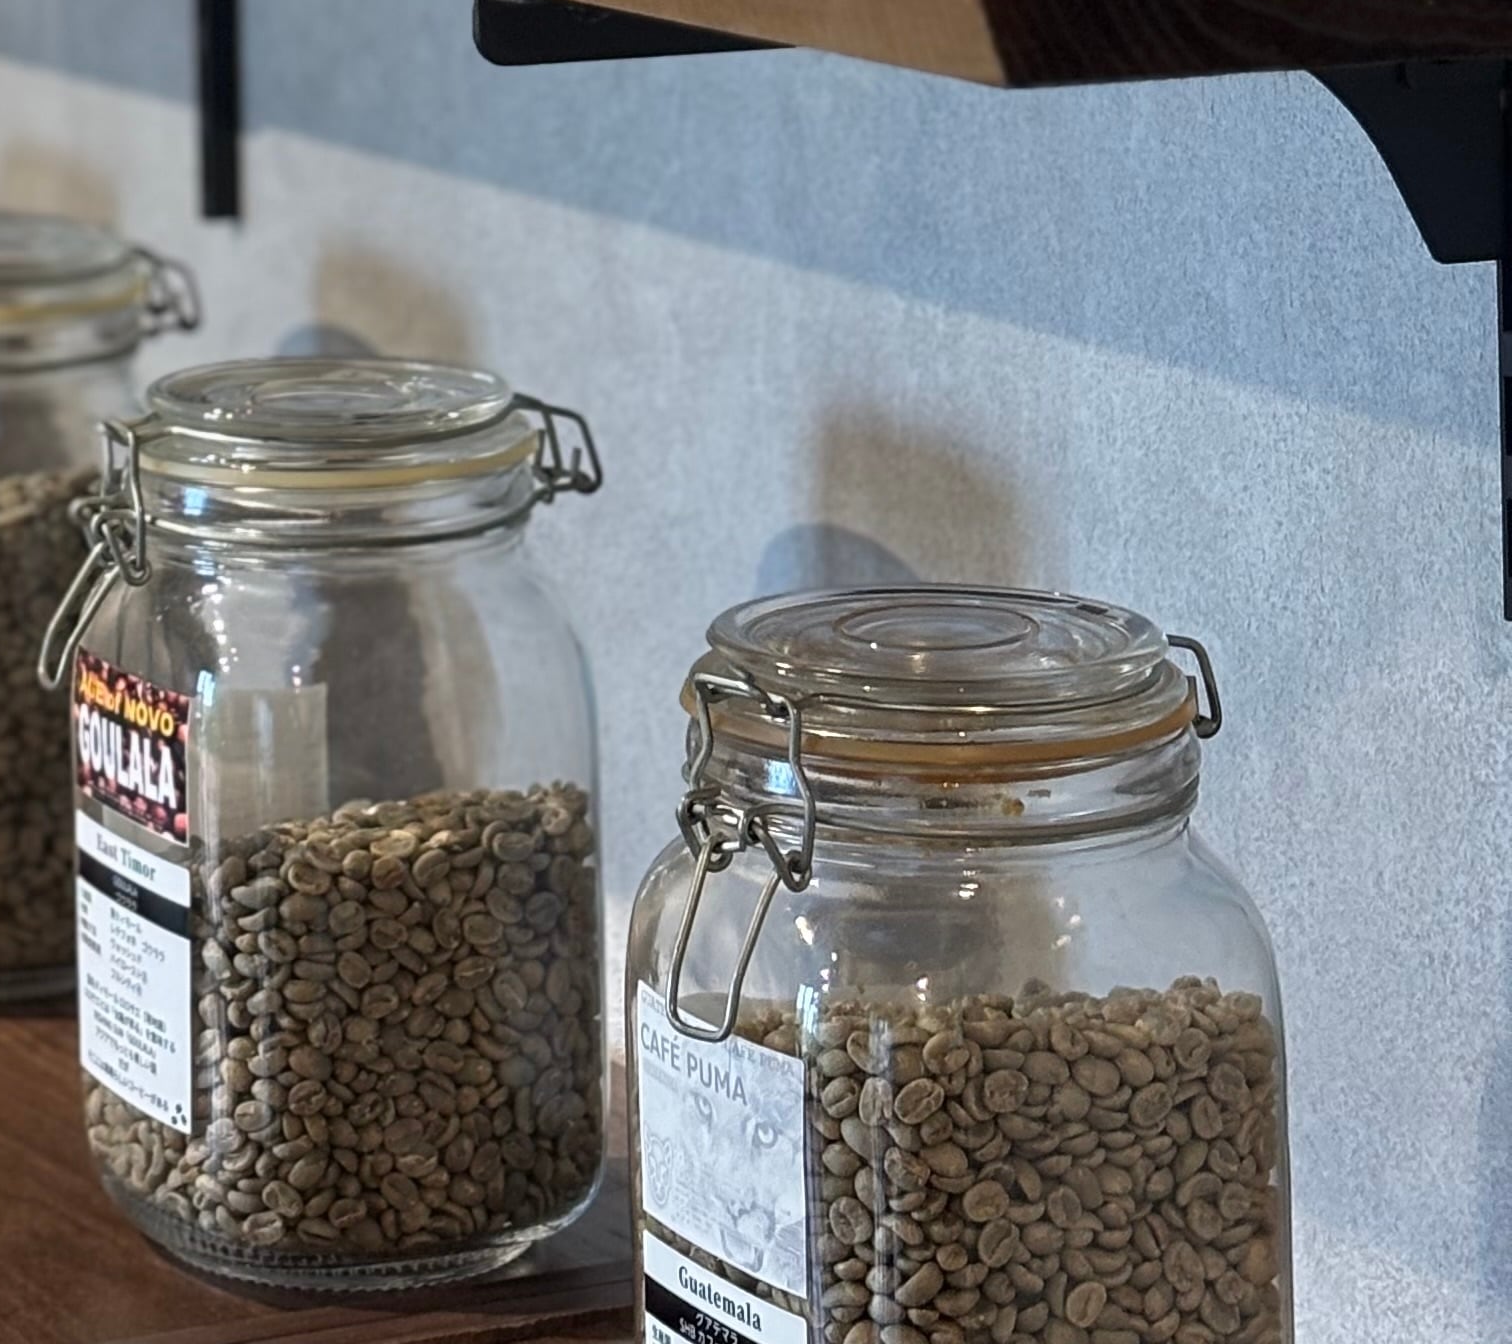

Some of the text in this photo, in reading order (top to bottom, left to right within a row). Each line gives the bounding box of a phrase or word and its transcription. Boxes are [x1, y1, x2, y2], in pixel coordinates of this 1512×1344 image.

[124, 698, 174, 737] NOVO
[78, 703, 177, 809] GOULALA
[96, 832, 156, 881] East Timor
[640, 1022, 681, 1072] CAFÉ
[687, 1052, 748, 1106] PUMA
[678, 1265, 762, 1332] Guatemala
